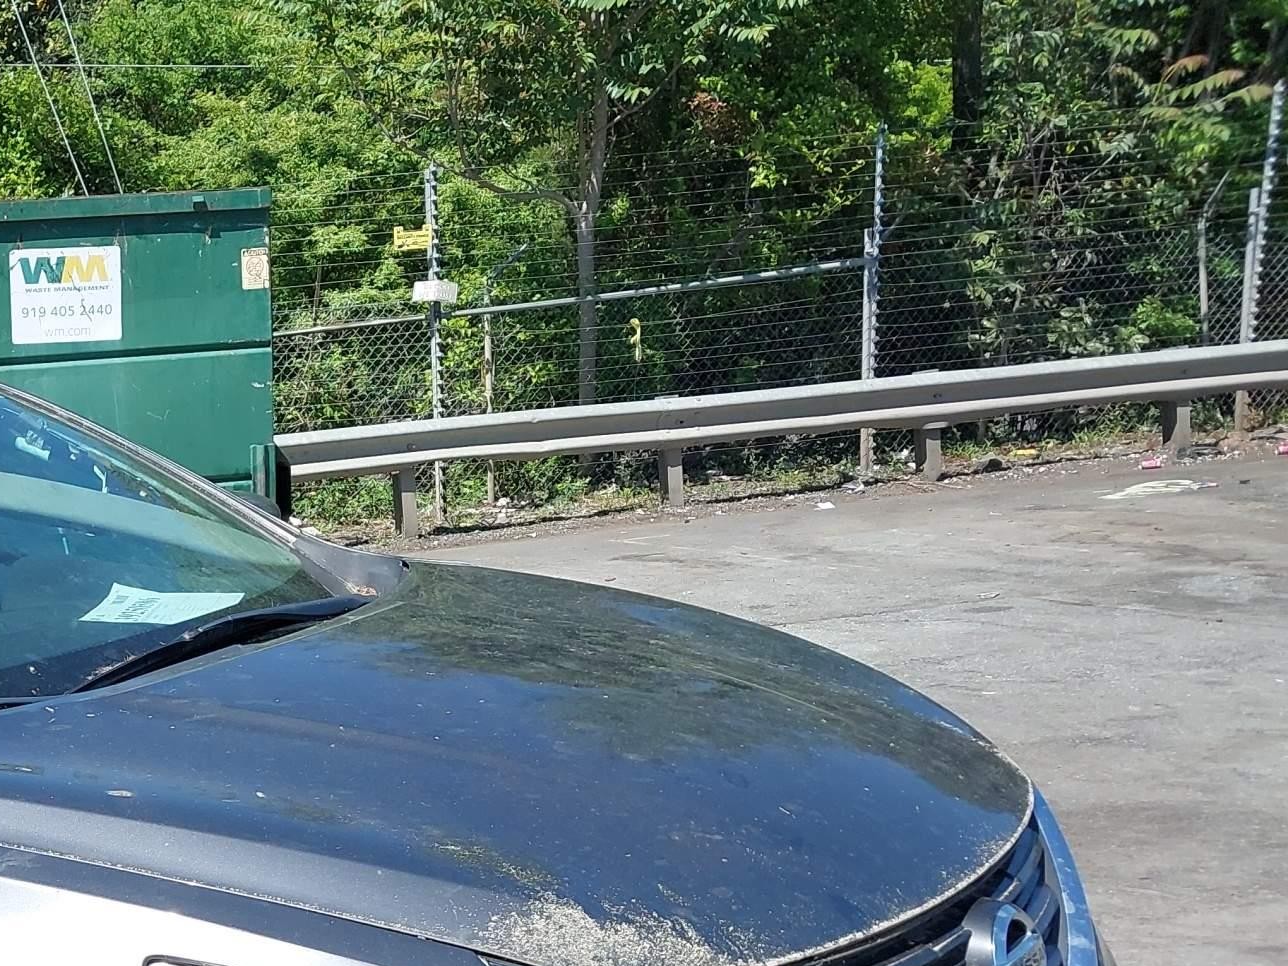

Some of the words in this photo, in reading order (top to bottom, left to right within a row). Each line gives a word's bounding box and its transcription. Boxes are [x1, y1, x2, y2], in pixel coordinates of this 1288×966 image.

[18, 254, 109, 285] WM
[54, 285, 109, 293] MANAGEMENT
[21, 305, 46, 318] 919
[50, 305, 75, 317] 405
[79, 303, 113, 317] 2440
[44, 327, 91, 337] wm.com
